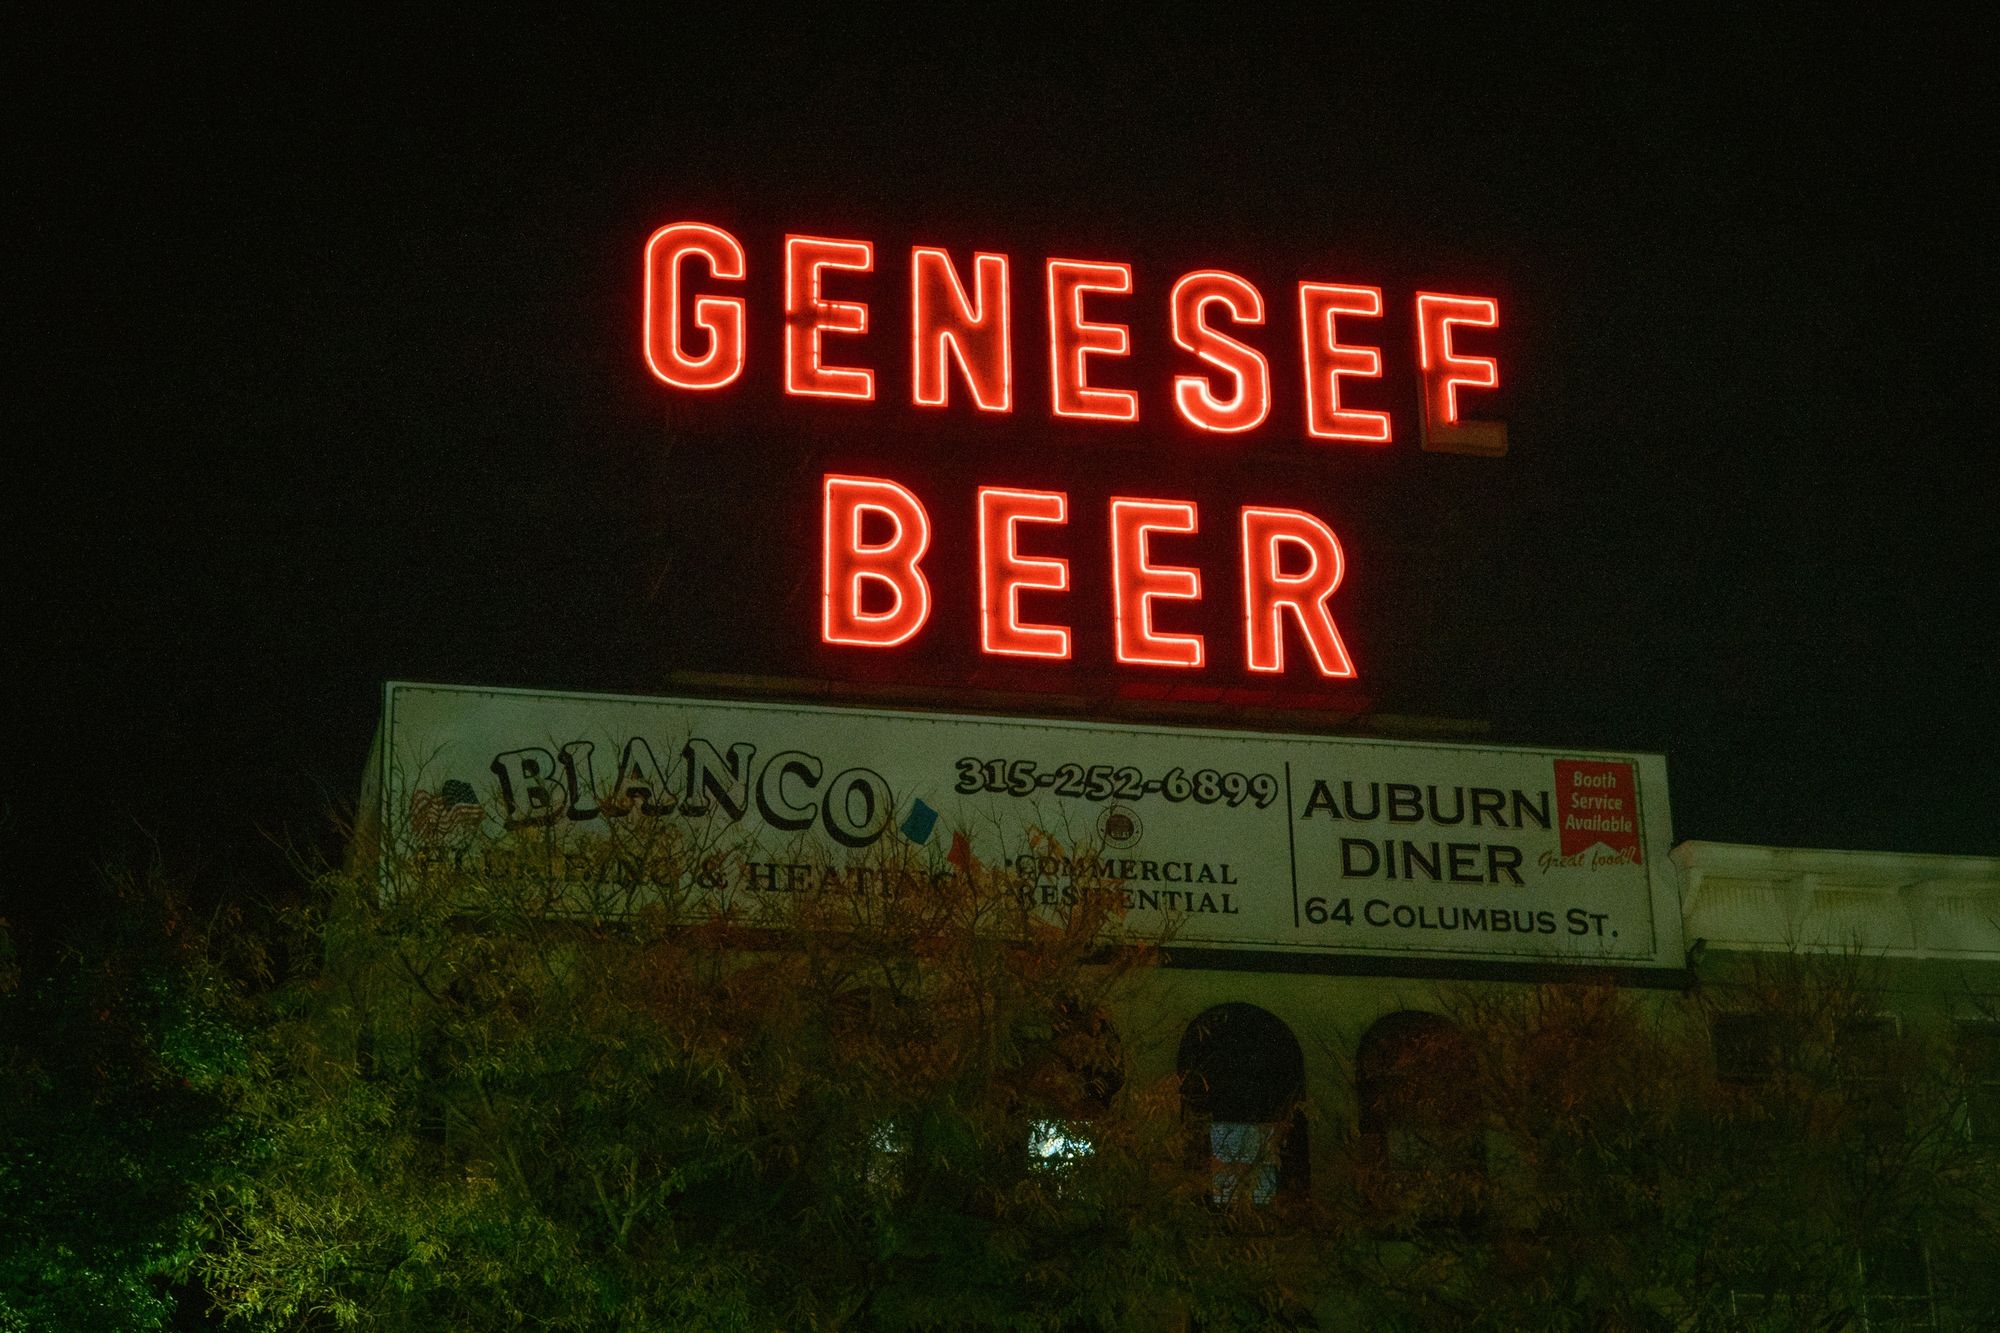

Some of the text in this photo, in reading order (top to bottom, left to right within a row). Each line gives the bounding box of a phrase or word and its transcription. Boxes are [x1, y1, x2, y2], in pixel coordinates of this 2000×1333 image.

[822, 473, 1358, 680] BEER
[490, 736, 893, 848] BIANCO
[955, 757, 1277, 808] 315-252-6899
[1573, 770, 1617, 789] Booth
[1301, 780, 1551, 830] AUBURN
[1571, 792, 1624, 812] Service
[1565, 814, 1634, 834] Available
[699, 858, 728, 890] &
[1015, 855, 1238, 885] COMMERCIAL
[1339, 837, 1526, 886] DINER
[1537, 849, 1586, 875] Great
[1305, 896, 1354, 926] 64
